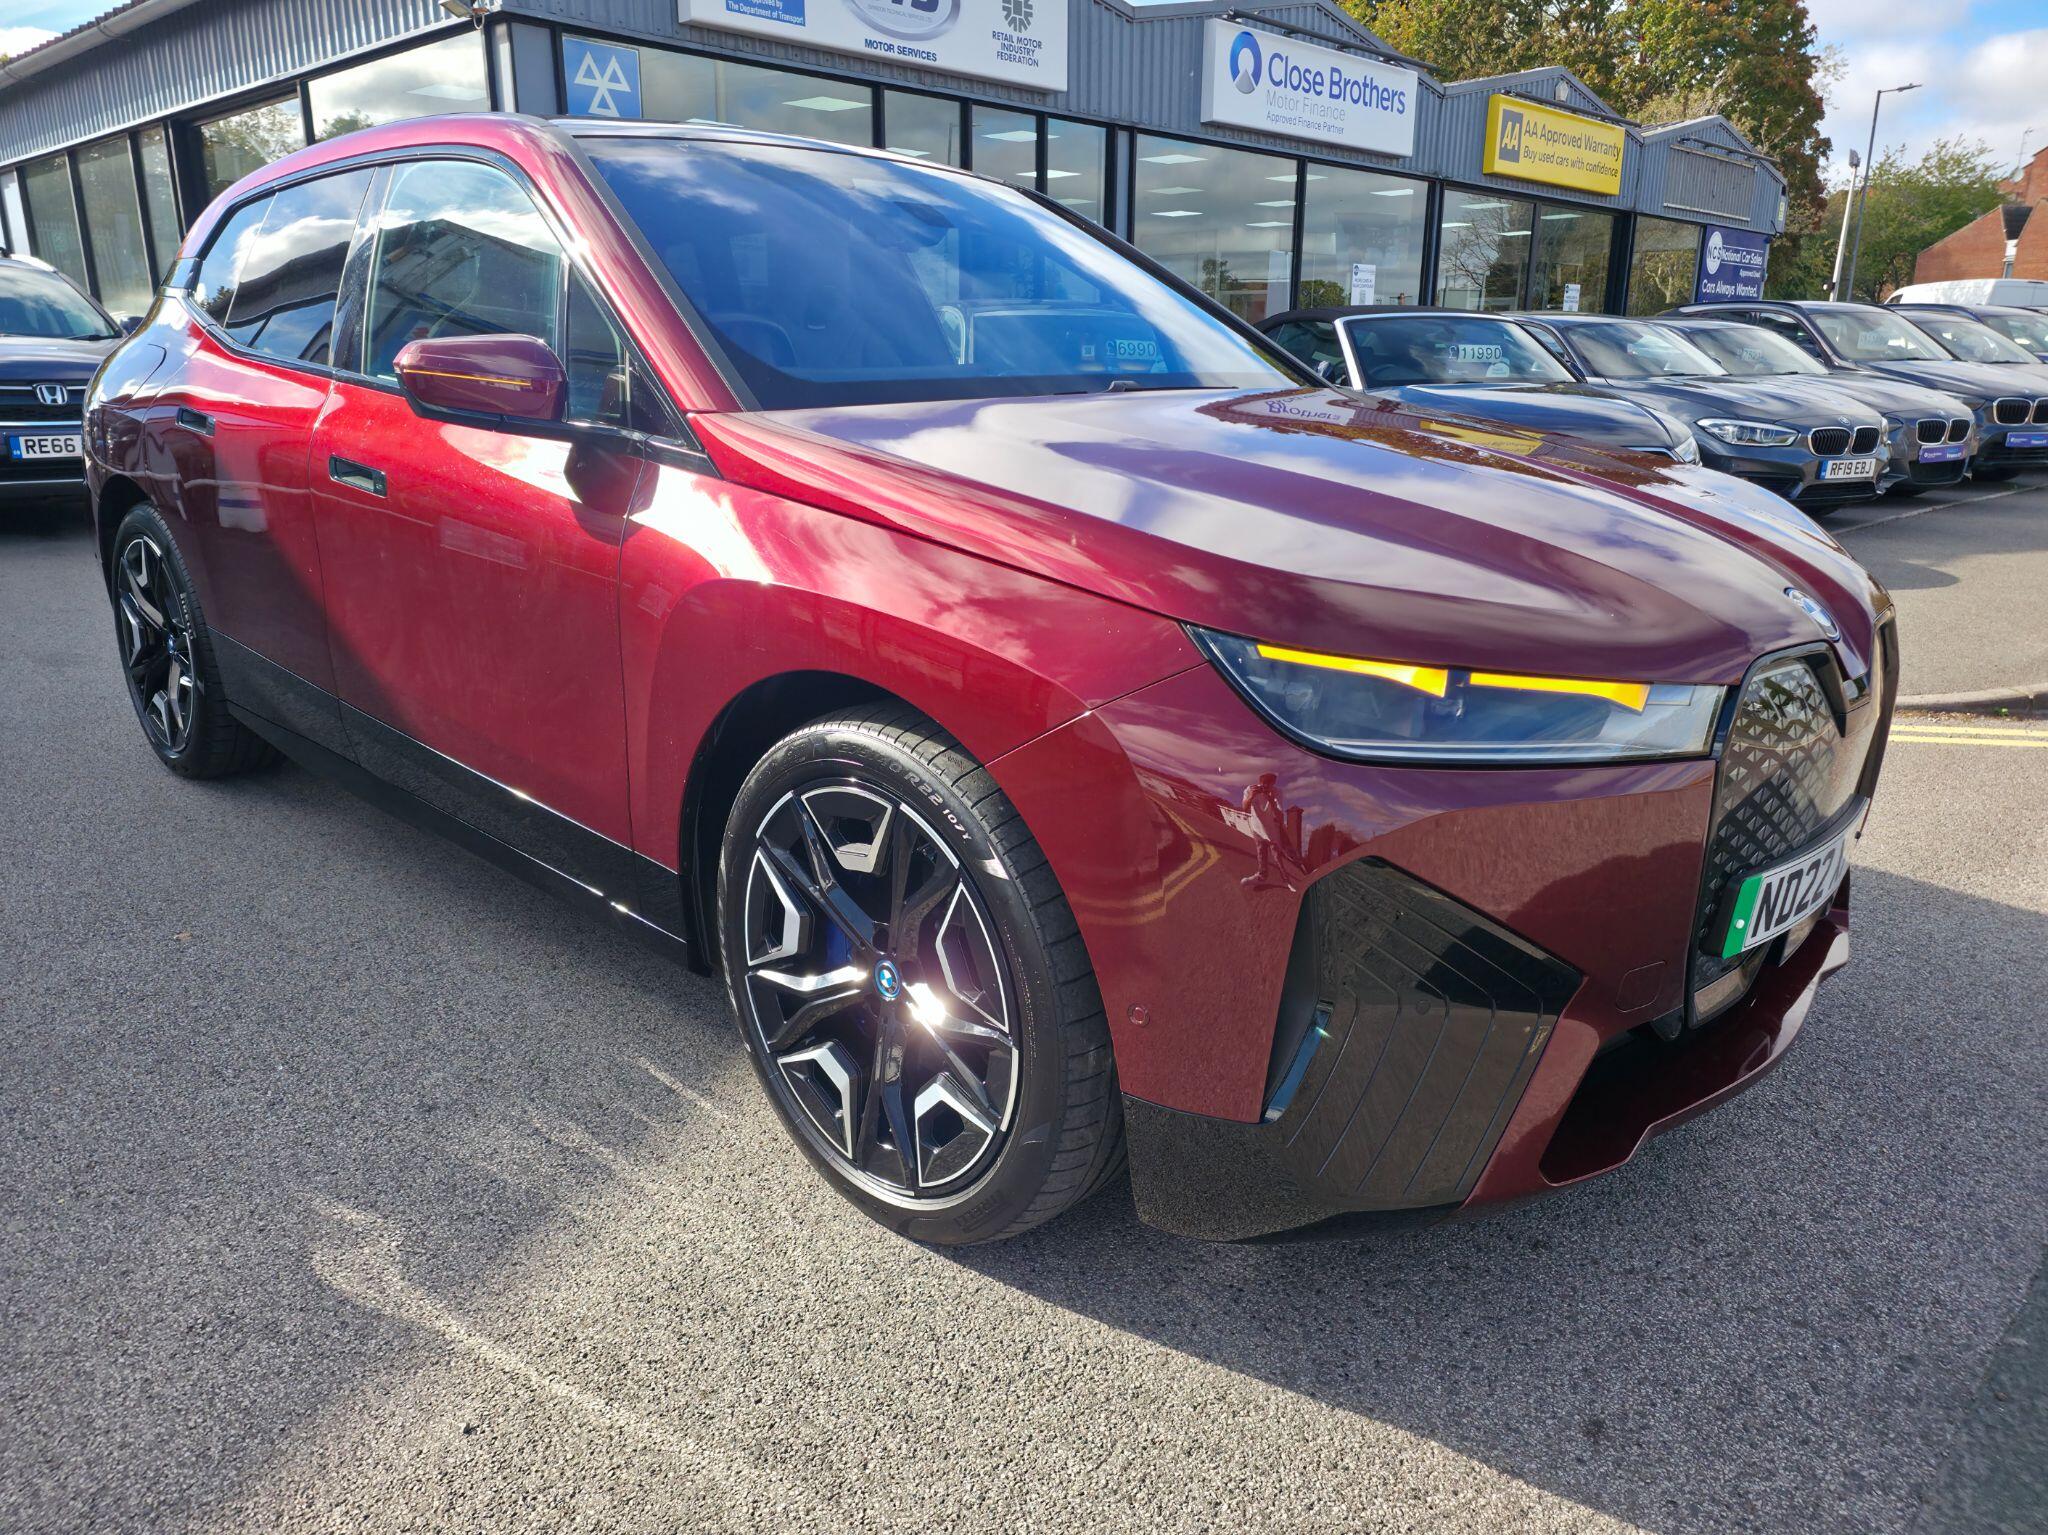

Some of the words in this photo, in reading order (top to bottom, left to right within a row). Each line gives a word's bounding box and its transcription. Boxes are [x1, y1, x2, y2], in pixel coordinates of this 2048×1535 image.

[728, 1, 739, 11] The
[740, 3, 771, 18] Department
[772, 9, 778, 18] of
[779, 12, 803, 24] Transport
[776, 0, 783, 9] by
[864, 38, 895, 54] MOTOR
[897, 45, 937, 62] SERVICES
[992, 30, 1014, 44] RETAIL
[1016, 36, 1042, 50] MOTOR
[1001, 42, 1036, 57] INDUSTRY
[997, 50, 1039, 68] FEDERATION
[1268, 52, 1324, 97] Close
[1329, 67, 1406, 115] Brothers
[1266, 89, 1299, 111] Motor
[1303, 97, 1345, 122] Finance
[1266, 110, 1296, 126] Approved
[1298, 116, 1321, 131] Finance
[1323, 121, 1344, 135] Partner
[1502, 121, 1520, 151] AA
[1524, 120, 1537, 139] AA
[1540, 124, 1582, 149] Approved
[1584, 134, 1621, 161] Warranty
[1523, 146, 1537, 164] Buy
[1539, 151, 1555, 165] used
[1556, 154, 1569, 167] cars
[1570, 157, 1584, 171] with
[1585, 159, 1619, 177] confidence
[1707, 246, 1721, 260] NCS
[1742, 251, 1751, 263] Car
[1751, 253, 1763, 265] Sales
[1702, 279, 1716, 293] Cars
[1716, 281, 1735, 298] Always
[24, 437, 76, 455] RE66
[1830, 461, 1853, 476] RF19
[1854, 461, 1873, 475] EBJ
[1751, 848, 1836, 939] ND22
